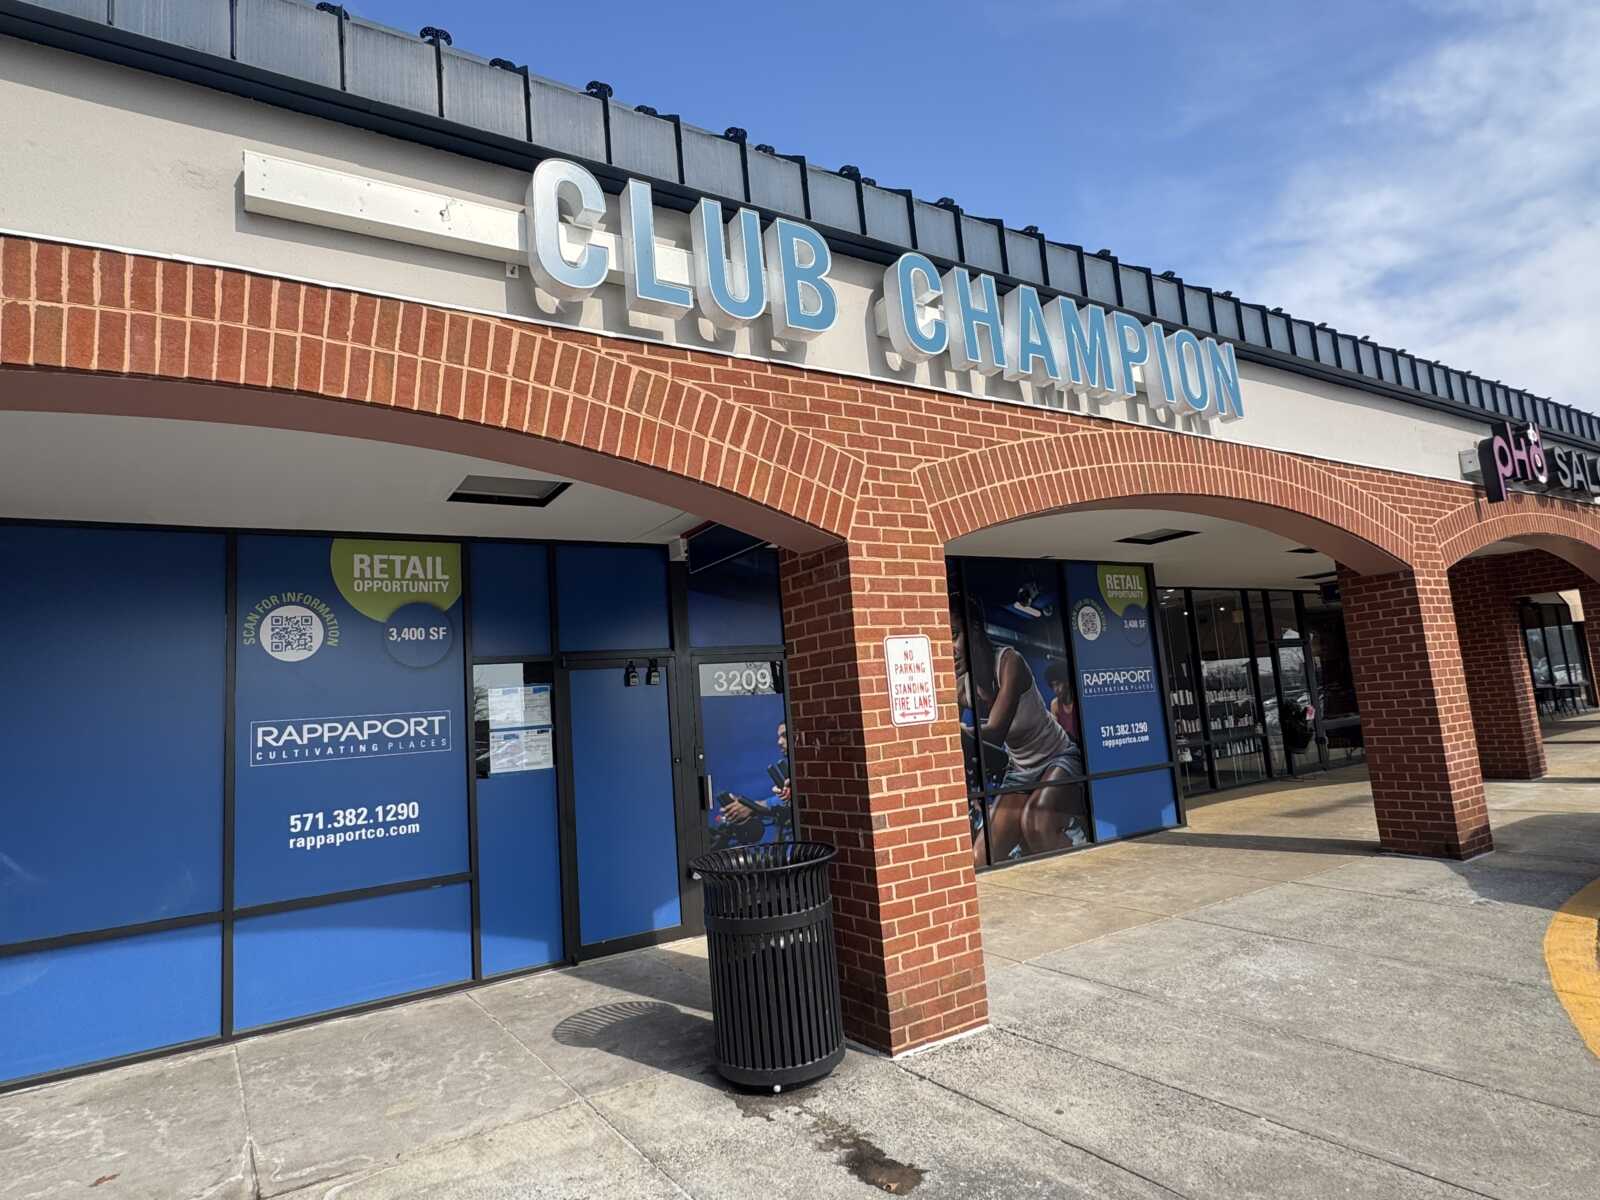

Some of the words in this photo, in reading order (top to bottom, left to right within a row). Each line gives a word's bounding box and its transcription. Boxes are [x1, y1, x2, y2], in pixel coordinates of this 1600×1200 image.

[531, 158, 839, 332] CLUB
[897, 252, 1244, 419] CHAMPION
[1554, 446, 1600, 493] SAL
[353, 554, 450, 579] RETAIL
[354, 580, 449, 593] OPPORTUNITY
[1105, 574, 1143, 590] RETAIL
[242, 612, 260, 645] SCAN
[255, 595, 280, 613] FOR
[281, 592, 340, 647] INFORMATION
[389, 627, 425, 642] 3,400
[429, 627, 447, 640] SF
[903, 649, 914, 661] NO
[894, 662, 926, 675] PARKING
[1083, 670, 1152, 686] RAPPAPORT
[713, 669, 770, 692] 3209
[894, 682, 930, 695] STANDING
[894, 696, 911, 711] FIRE
[913, 695, 933, 710] LANE
[257, 716, 446, 748] RAPPAPORT
[1101, 722, 1148, 738] 571.382.1290
[256, 743, 378, 761] CULTIVATING
[387, 738, 447, 751] PLACES
[289, 801, 420, 833] 571.382.1290
[289, 822, 421, 850] rappaportco.com
